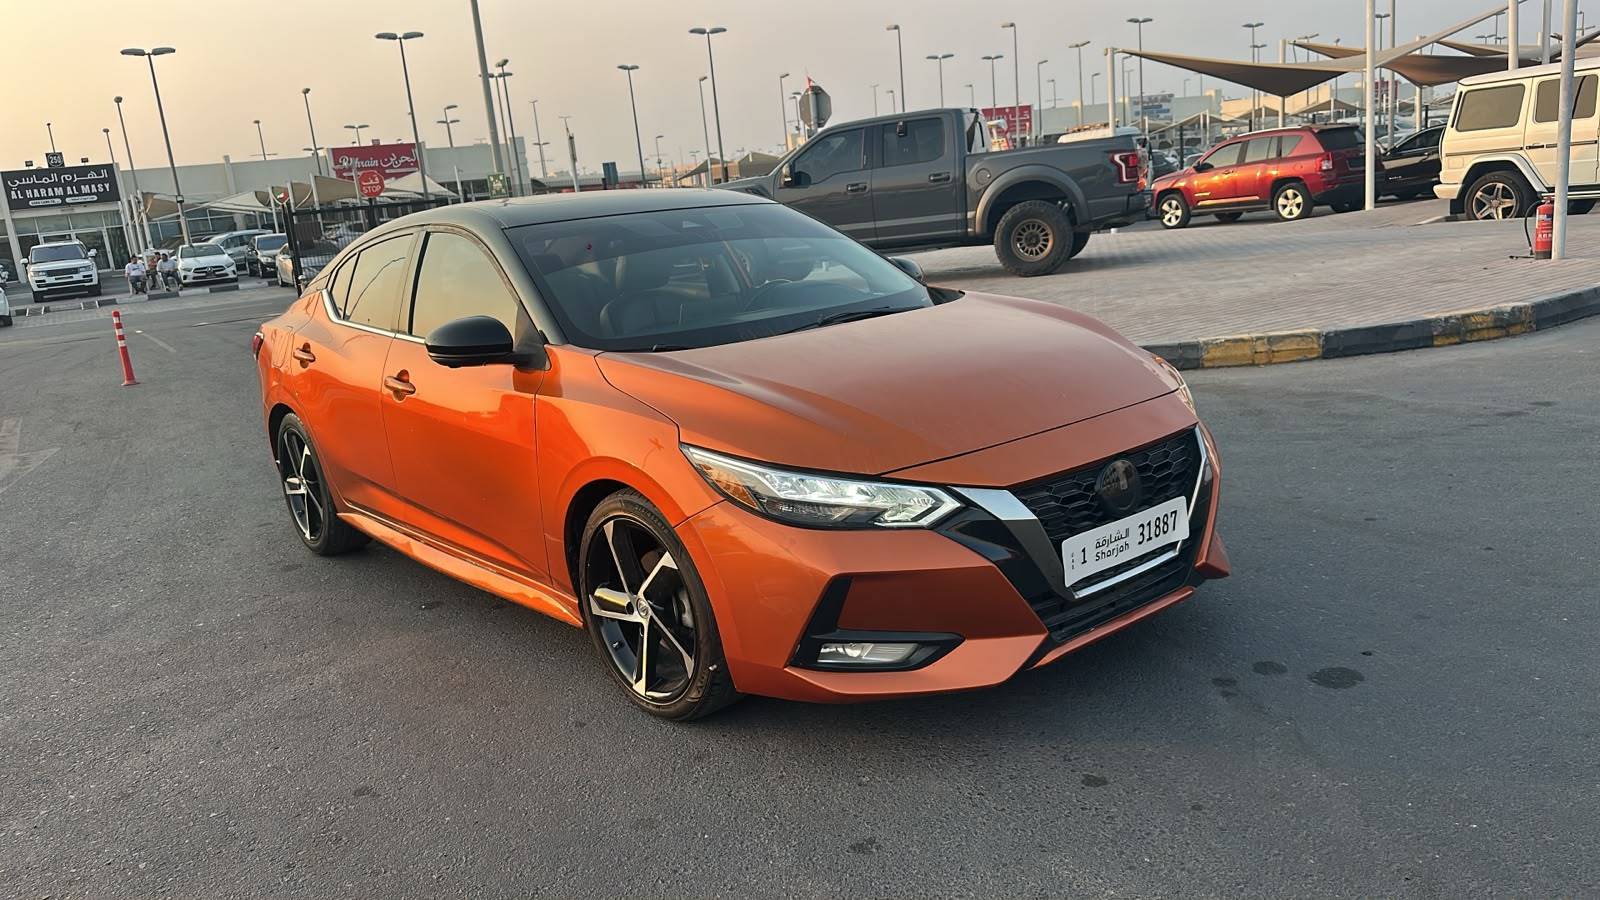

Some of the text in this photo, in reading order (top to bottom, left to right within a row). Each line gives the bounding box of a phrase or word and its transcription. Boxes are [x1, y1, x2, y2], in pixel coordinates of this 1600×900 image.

[49, 156, 62, 164] 250
[380, 148, 418, 168] لبحرين
[8, 169, 108, 190] الهرم الماسي
[361, 175, 380, 185] قف
[11, 190, 23, 200] AL
[26, 187, 64, 199] HARAM
[67, 185, 79, 195] AL
[81, 183, 111, 194] MASY
[362, 185, 381, 194] STOP
[1137, 509, 1178, 546] 31887
[1095, 527, 1130, 549] الشارقة
[1081, 547, 1088, 565] 1
[1095, 541, 1130, 562] Sharjah
